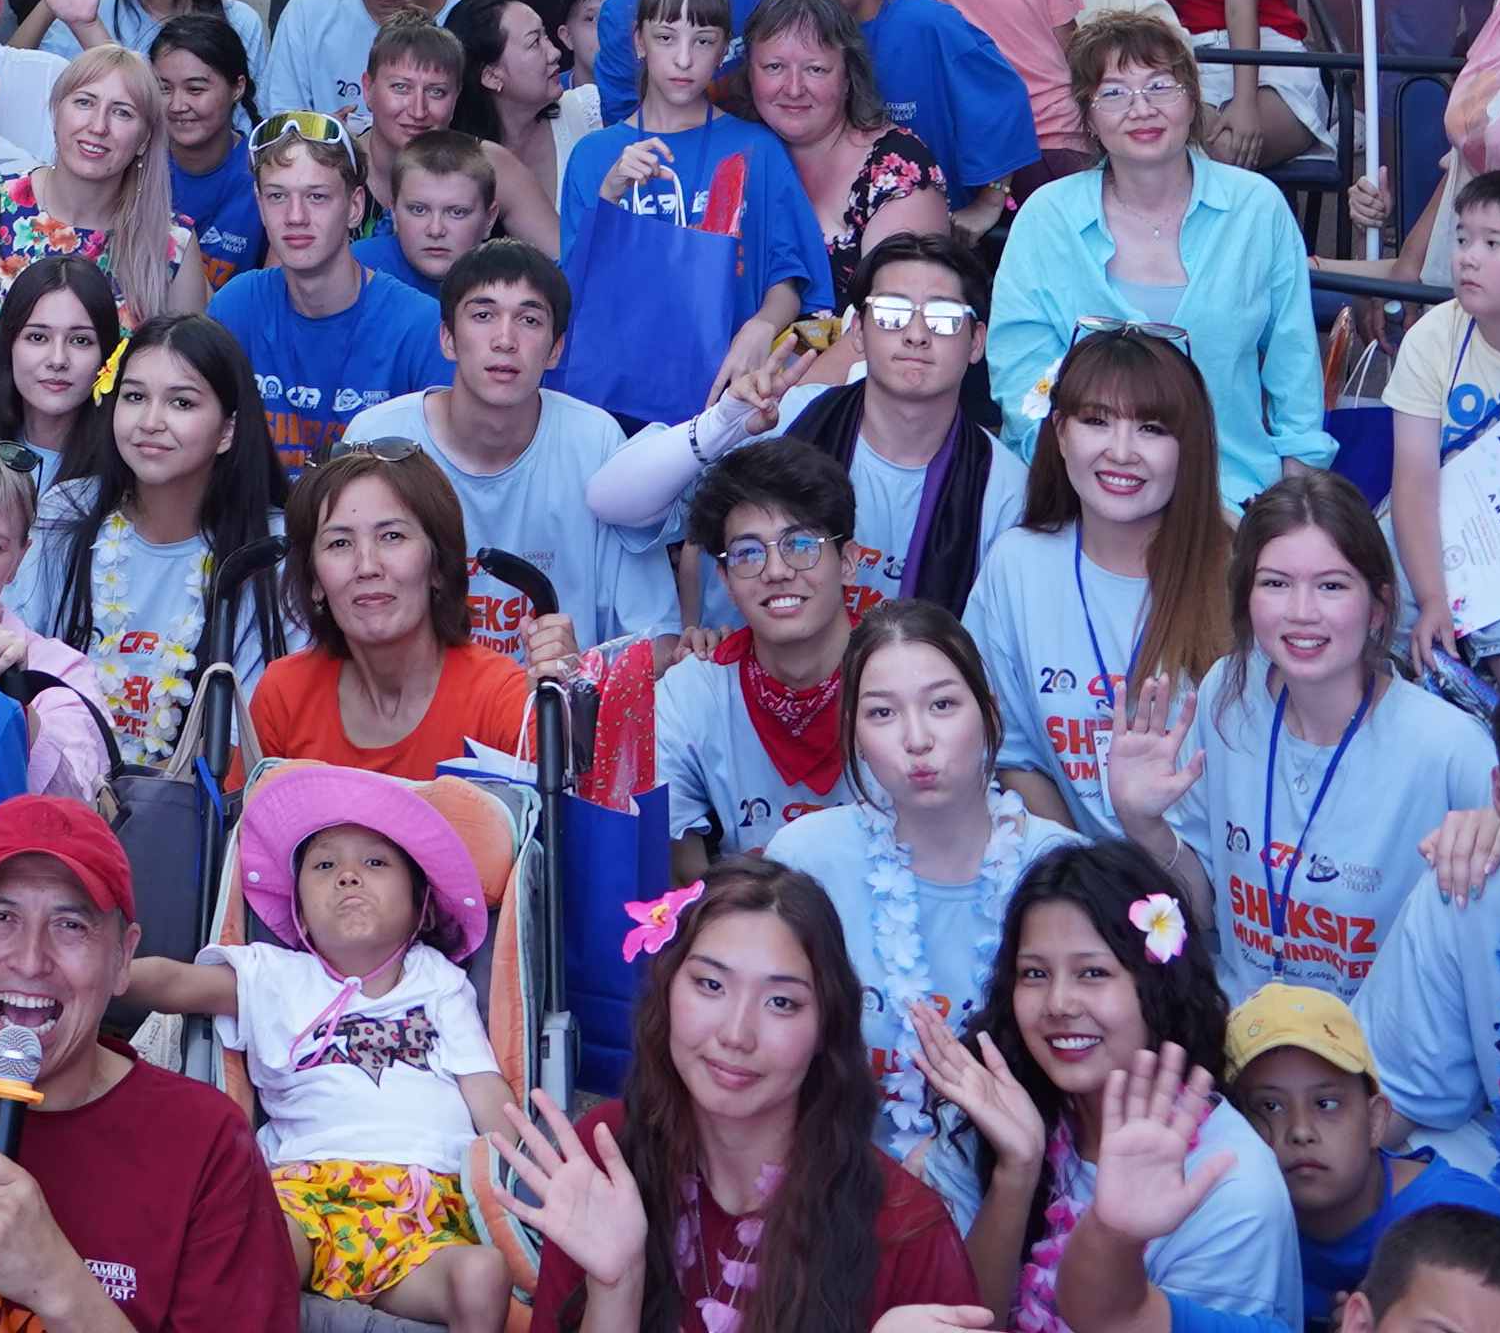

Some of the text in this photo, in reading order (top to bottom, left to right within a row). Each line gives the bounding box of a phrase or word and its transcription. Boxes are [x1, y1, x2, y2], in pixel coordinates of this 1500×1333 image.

[336, 79, 361, 98] 20
[1040, 667, 1076, 693] 20
[1229, 874, 1377, 954] SHKSIZ
